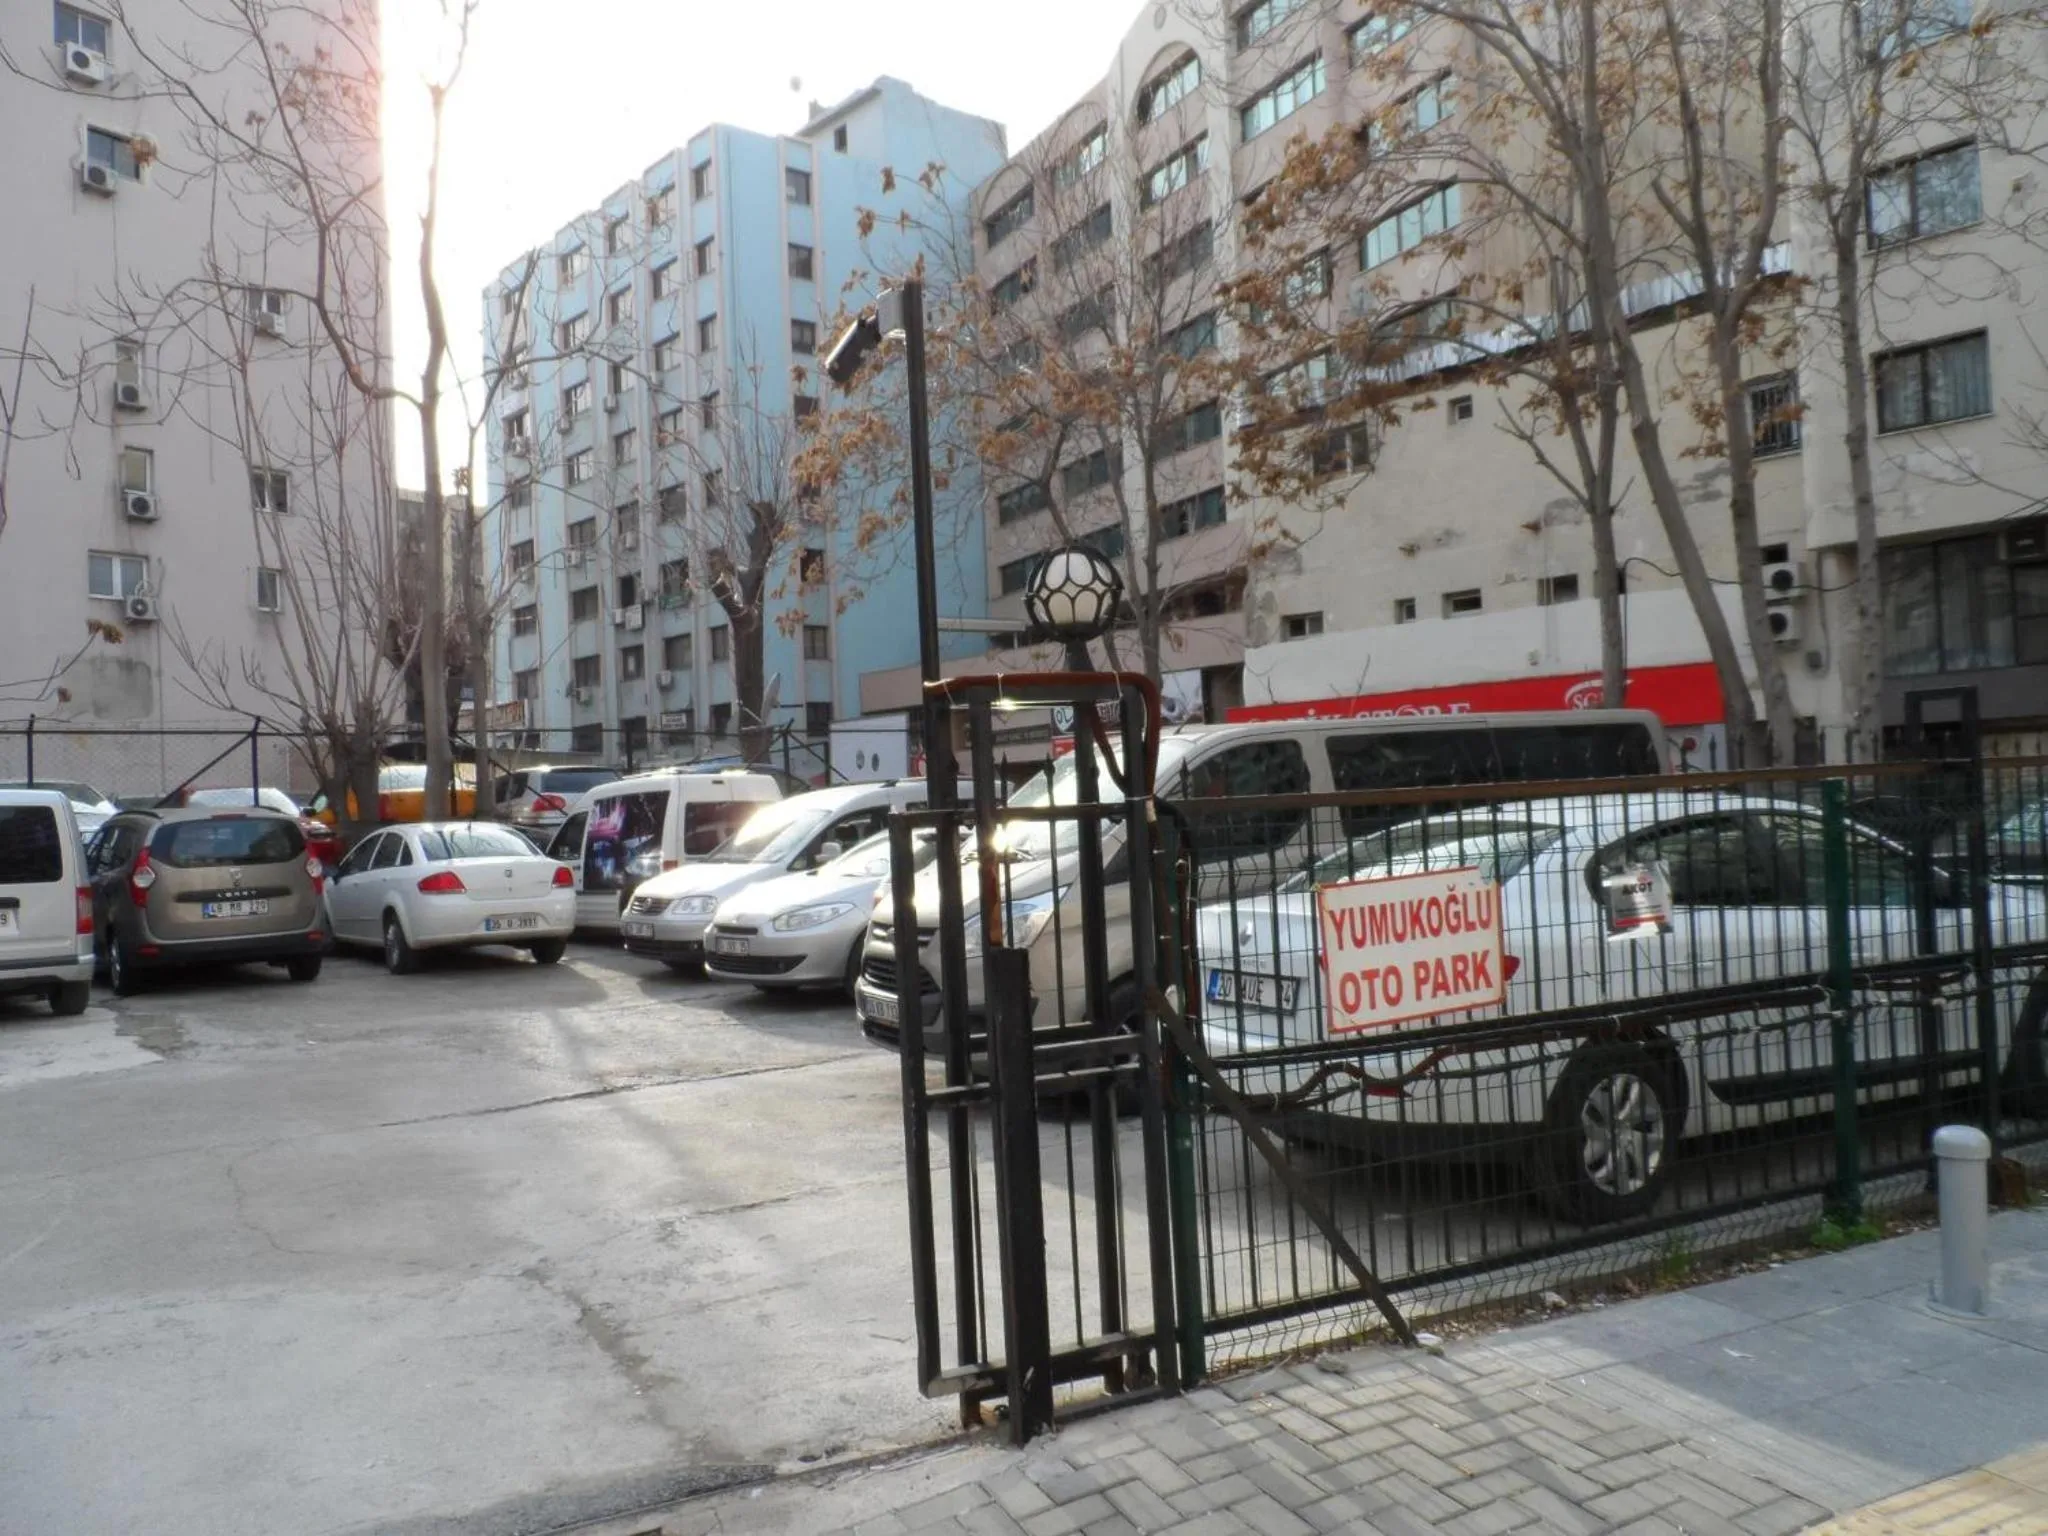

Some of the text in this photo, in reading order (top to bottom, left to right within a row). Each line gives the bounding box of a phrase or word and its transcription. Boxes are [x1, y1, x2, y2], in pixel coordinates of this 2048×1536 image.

[1329, 884, 1492, 950] YUMUKOĞLU
[1339, 950, 1493, 1015] OTO PARK
